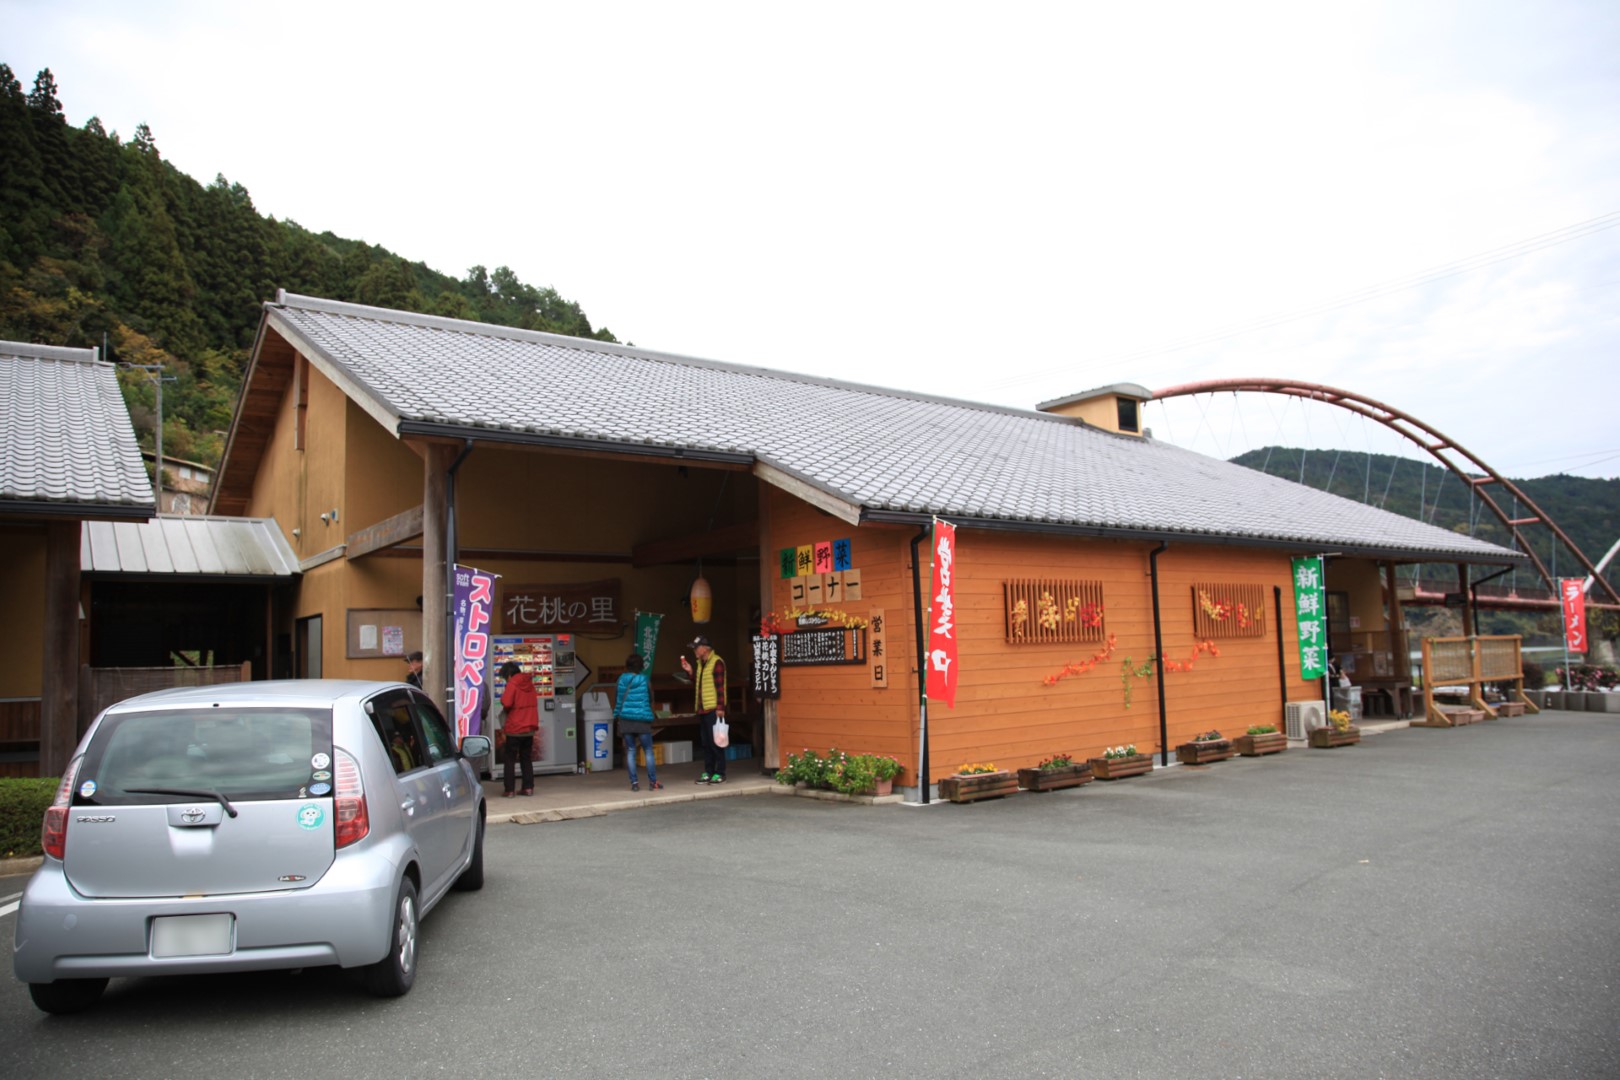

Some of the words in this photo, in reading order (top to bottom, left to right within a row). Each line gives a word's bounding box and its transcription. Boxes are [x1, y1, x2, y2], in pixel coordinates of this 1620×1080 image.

[782, 541, 849, 576] 新鮮野菜
[507, 595, 617, 624] 花桃の里
[793, 576, 859, 600] コーナー
[1296, 564, 1321, 671] 新鮮野菜
[1566, 585, 1583, 646] ラーメン
[459, 575, 491, 737] ストロベリー
[761, 641, 770, 692] 花桃カレー
[871, 615, 884, 681] 営業日
[77, 815, 116, 823] PASSO
